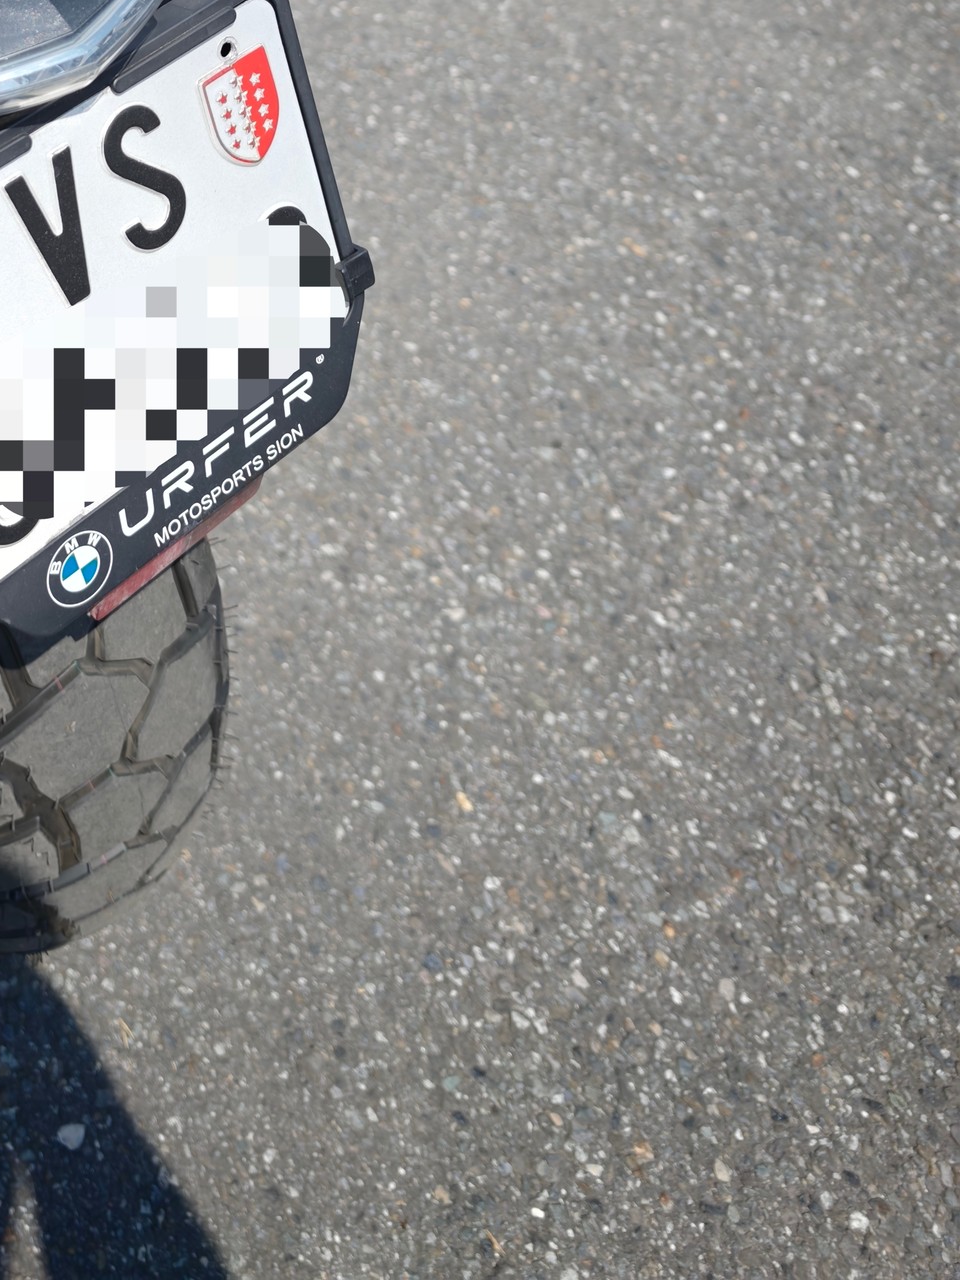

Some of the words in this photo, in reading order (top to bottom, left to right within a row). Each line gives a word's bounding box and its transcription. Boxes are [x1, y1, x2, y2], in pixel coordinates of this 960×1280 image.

[4, 104, 187, 306] VS
[118, 370, 314, 538] URFER
[153, 454, 264, 548] MOTOSPORTS
[266, 423, 305, 461] SION
[49, 532, 102, 576] BMW
